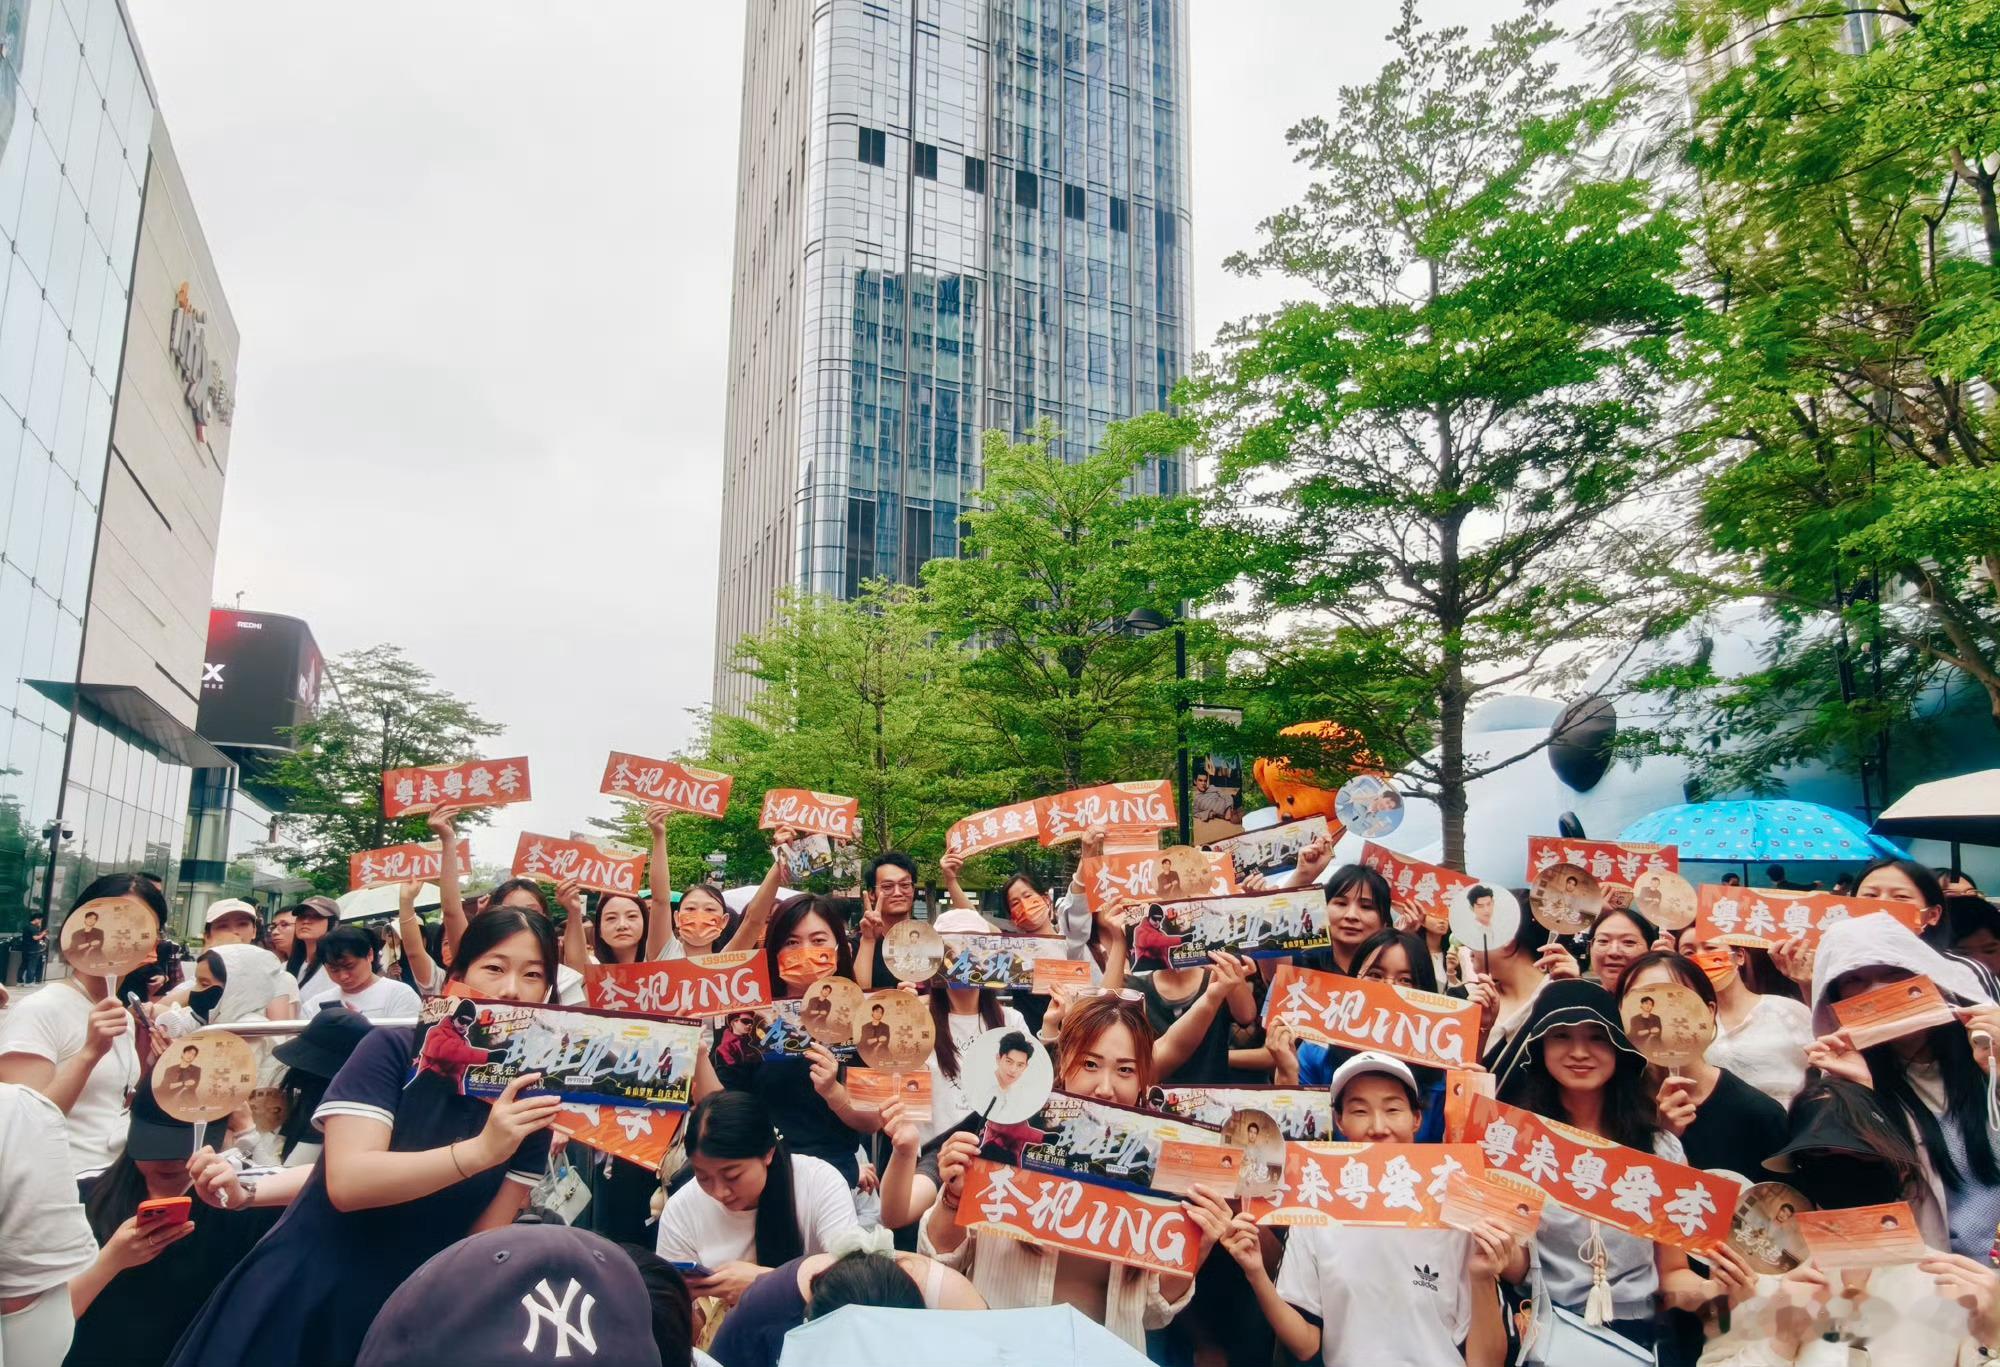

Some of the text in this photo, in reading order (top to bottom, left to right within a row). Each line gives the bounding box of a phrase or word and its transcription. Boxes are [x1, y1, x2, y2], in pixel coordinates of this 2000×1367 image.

[394, 764, 522, 806] 粤来粤爱李
[609, 758, 720, 812] 李现ING
[1045, 793, 1169, 838] 李现ING
[357, 850, 465, 884] 李现IN
[520, 840, 634, 891] 李现ING
[702, 952, 748, 965] 19911019
[597, 968, 763, 1012] 李现ING
[1407, 990, 1459, 1010] 19911019
[1276, 975, 1464, 1066] 李现ING
[1477, 1116, 1717, 1237] 粤来粤爱李
[1486, 1170, 1545, 1201] 19911019
[976, 1166, 1187, 1266] 李现ING
[1271, 1214, 1328, 1226] 19911019
[1412, 1280, 1438, 1292] adidas
[521, 1277, 598, 1358] NY
